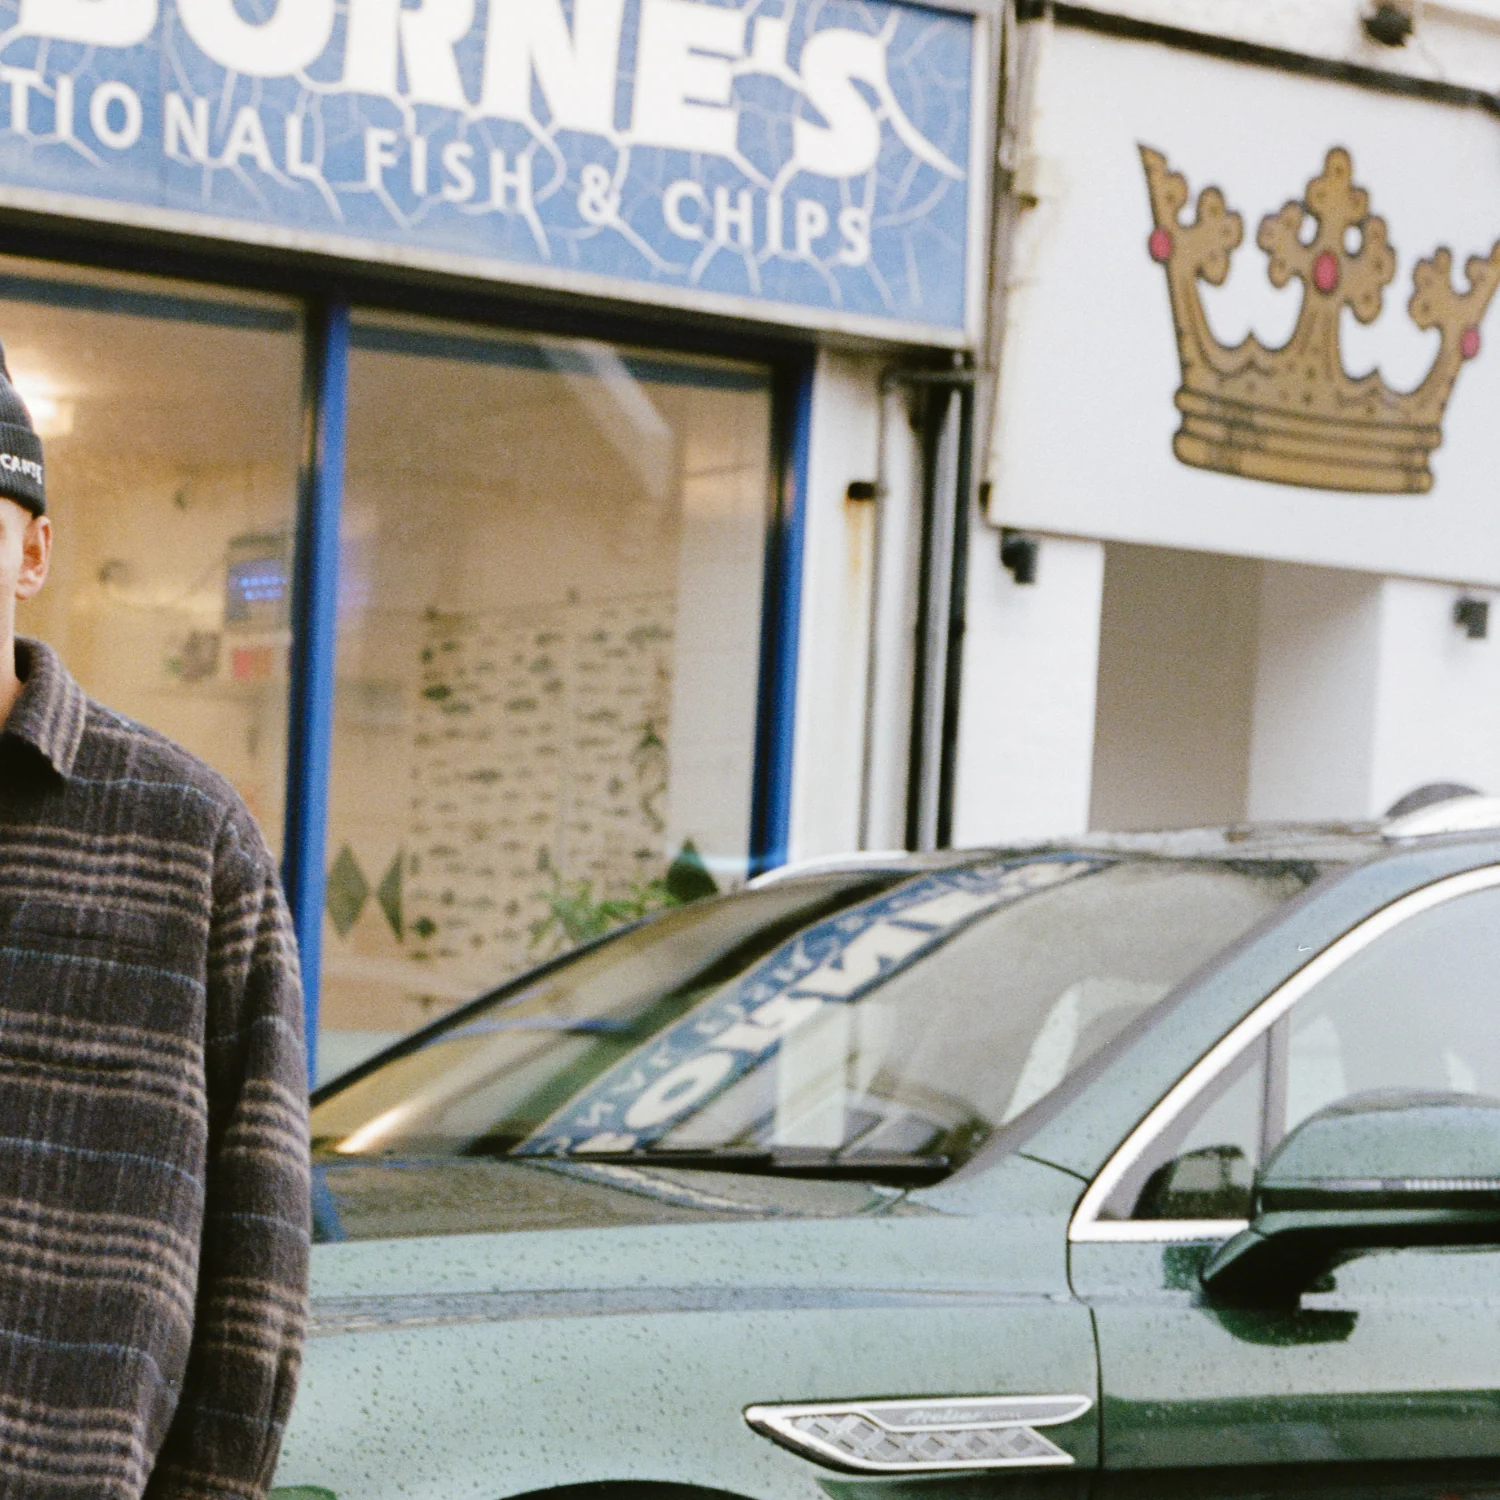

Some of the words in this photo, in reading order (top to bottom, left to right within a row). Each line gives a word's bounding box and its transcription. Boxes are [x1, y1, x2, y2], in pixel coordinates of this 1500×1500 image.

[364, 126, 531, 210] FISH
[579, 163, 621, 223] &
[662, 180, 870, 265] CHIPS
